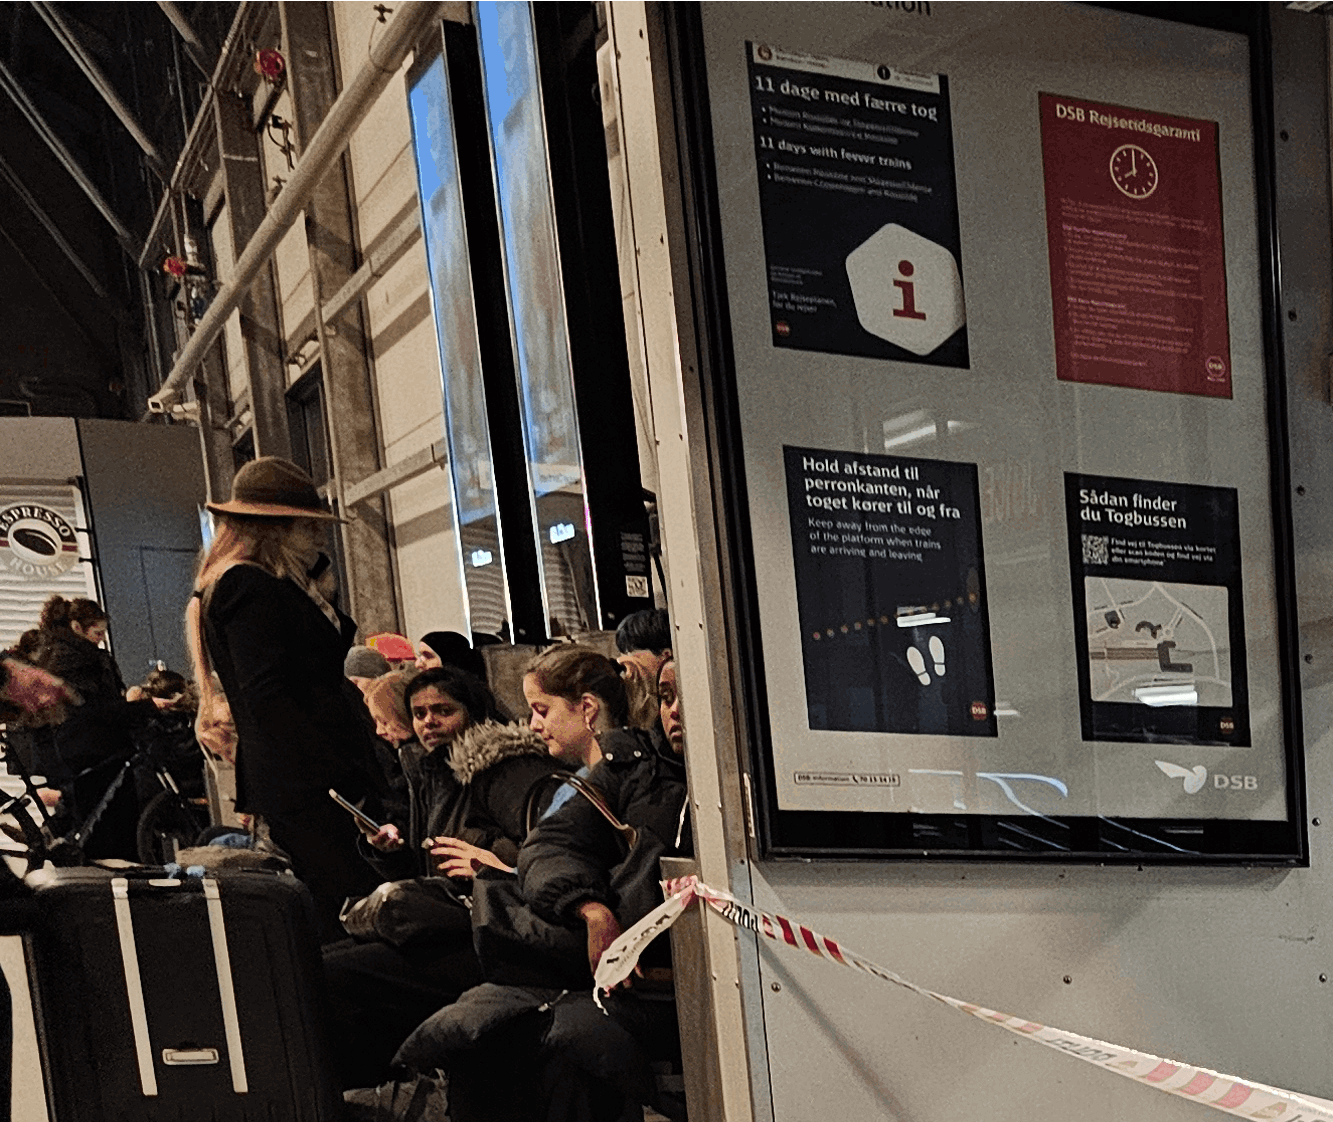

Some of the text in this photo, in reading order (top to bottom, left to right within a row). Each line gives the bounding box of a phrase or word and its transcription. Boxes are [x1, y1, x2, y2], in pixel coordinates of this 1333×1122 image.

[755, 75, 939, 122] 11 dage med færre tog
[1056, 103, 1086, 123] DSB
[760, 136, 913, 171] 11 days with fewer trains
[802, 457, 920, 481] Hold afstand til
[804, 477, 941, 500] perronkanten, når
[1079, 488, 1178, 512] Sådan finder
[805, 494, 961, 520] toget kører til og fra
[1080, 506, 1187, 530] du Togbussen
[0, 506, 71, 537] ESPRESSO
[808, 517, 932, 537] Keep away from the edge
[809, 530, 942, 550] of the platform when trains
[810, 545, 924, 563] are arriving and leaving
[10, 557, 68, 577] HOUSE
[971, 706, 988, 715] DSB
[1213, 774, 1259, 790] DSB
